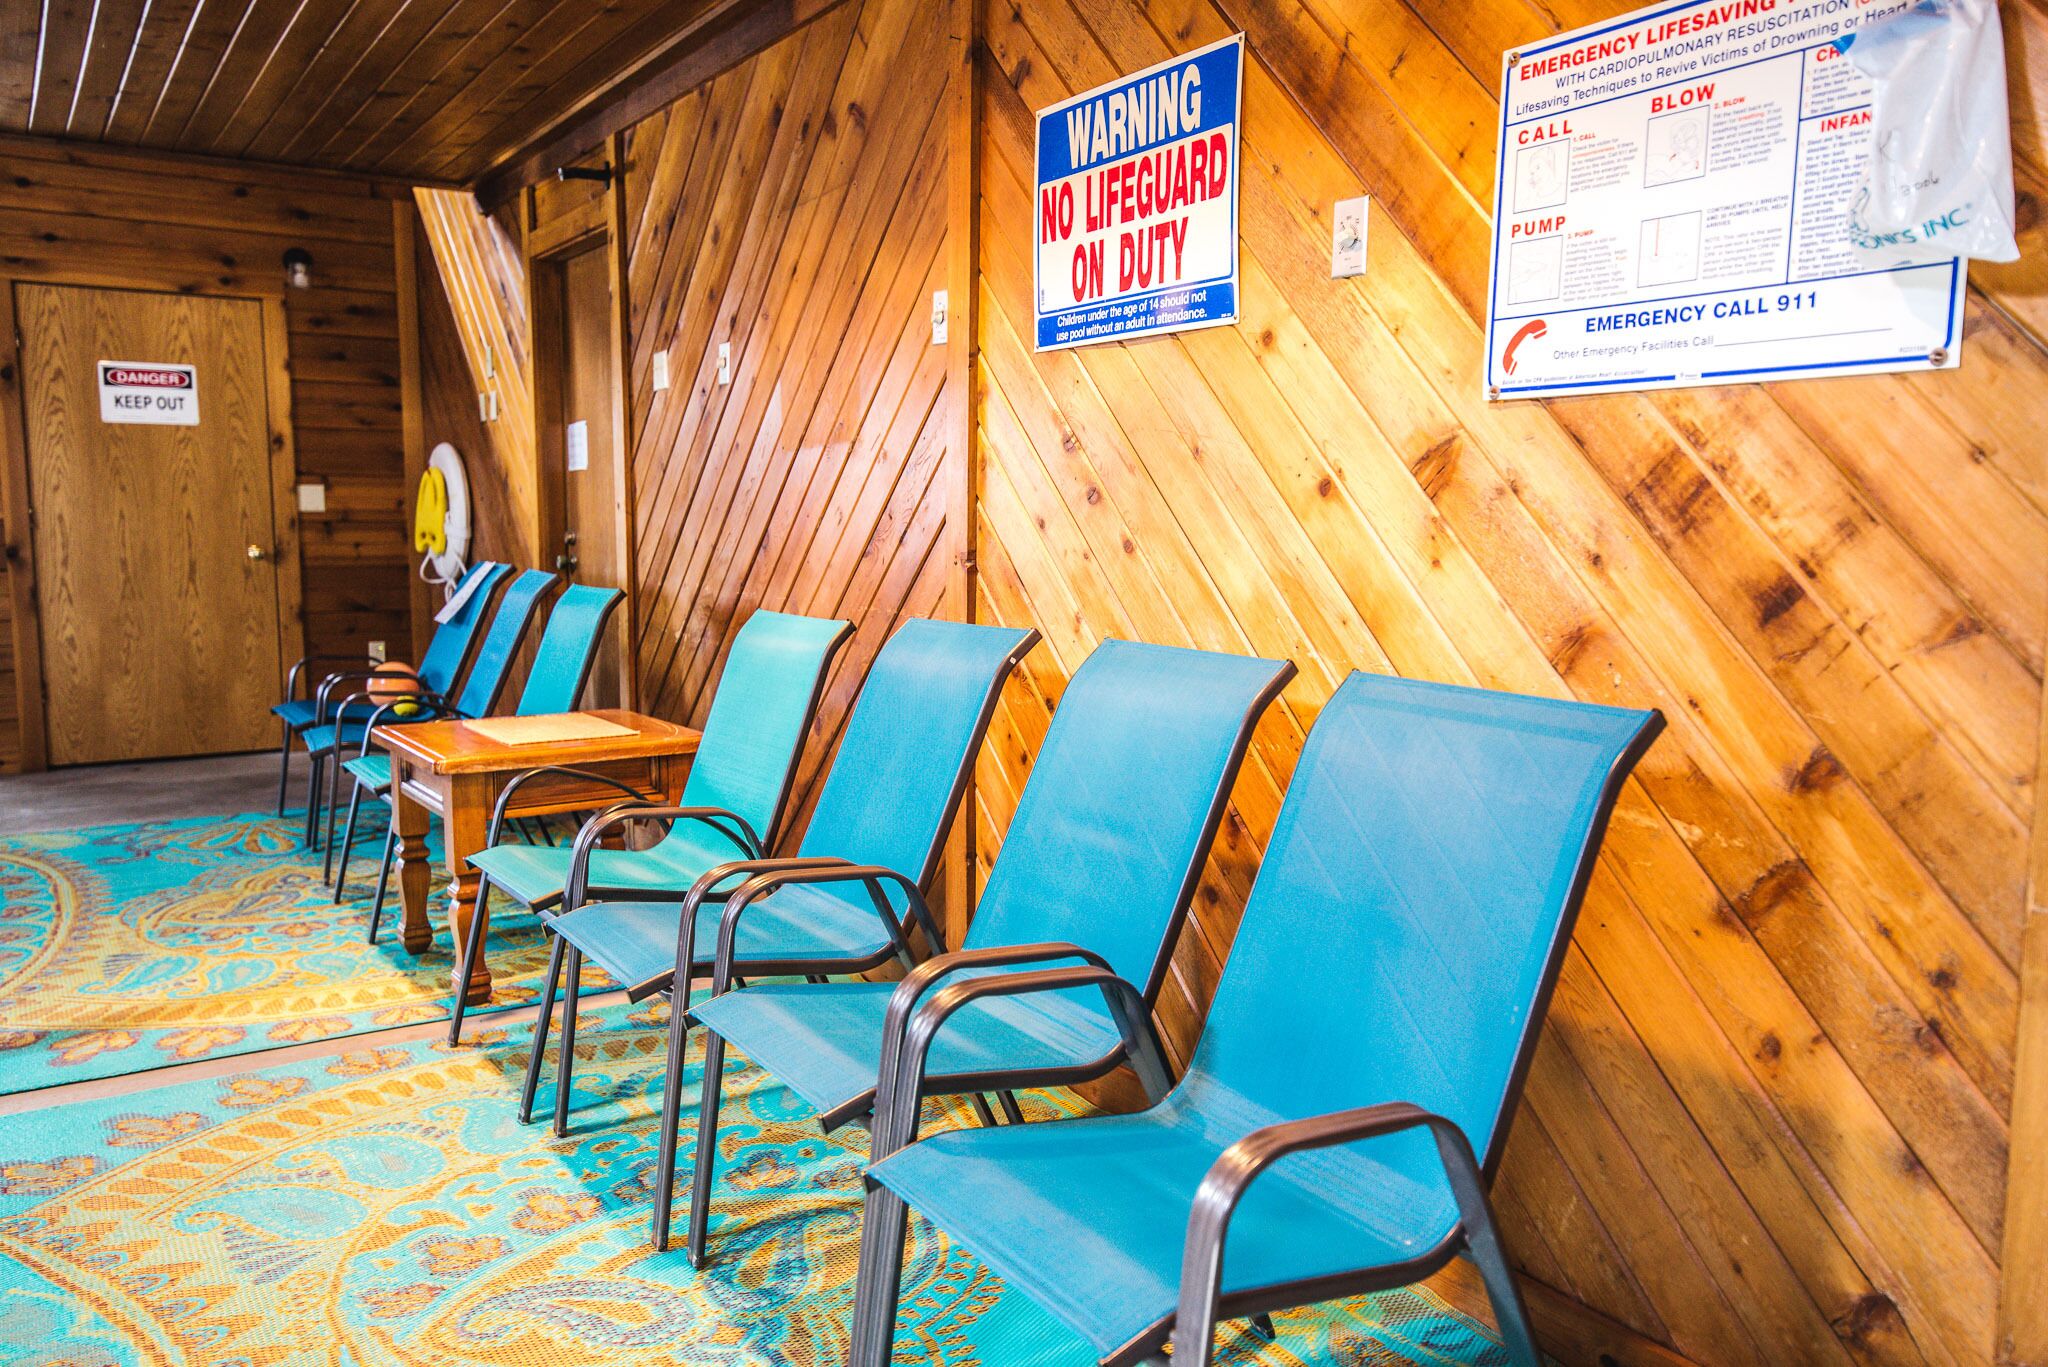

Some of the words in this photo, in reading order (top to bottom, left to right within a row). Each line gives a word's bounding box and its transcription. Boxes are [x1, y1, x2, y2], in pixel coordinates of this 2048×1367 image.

[1520, 31, 1641, 81] EMERGENCY
[1646, 0, 1775, 45] LIFESAVING
[1556, 71, 1585, 89] WITH
[1589, 33, 1722, 80] CARDIOPULMONARY
[1727, 0, 1848, 42] RESUSCITATION
[1516, 94, 1569, 116] Lifesaving
[1573, 75, 1637, 100] Techniques
[1641, 71, 1652, 82] to
[1656, 57, 1697, 78] Revive
[1701, 45, 1748, 66] Victims
[1753, 38, 1766, 53] of
[1771, 21, 1839, 48] Drowning
[1844, 16, 1860, 29] or
[1865, 3, 1907, 22] Heart
[1066, 63, 1201, 169] WARNING
[1651, 83, 1716, 114] BLOW
[1518, 119, 1573, 145] CALL
[1042, 182, 1074, 244] NO
[1086, 132, 1227, 233] LIFEGUARD
[1511, 216, 1567, 238] PUMP
[1072, 239, 1104, 302] ON
[1119, 216, 1189, 293] DUTY
[1056, 331, 1069, 341] use
[1070, 326, 1085, 342] pool
[1086, 321, 1113, 336] without
[1114, 322, 1124, 331] an
[1125, 316, 1146, 329] adult
[1147, 315, 1155, 325] in
[1156, 307, 1208, 325] attendance.
[1057, 313, 1086, 327] Children
[1087, 306, 1109, 321] under
[1110, 305, 1122, 317] the
[1123, 305, 1137, 317] age
[1138, 301, 1147, 312] of
[1149, 300, 1158, 310] 14
[1159, 293, 1190, 309] should
[1191, 290, 1207, 303] not
[1586, 305, 1707, 333] EMERGENCY
[1713, 297, 1769, 319] CALL
[1777, 291, 1817, 312] 911
[1553, 349, 1580, 361] Other
[1583, 341, 1638, 358] Emergency
[1641, 336, 1689, 352] Facilities
[1692, 335, 1714, 346] Call
[116, 371, 180, 385] DANGER
[114, 395, 152, 409] KEEP
[156, 396, 185, 410] OUT
